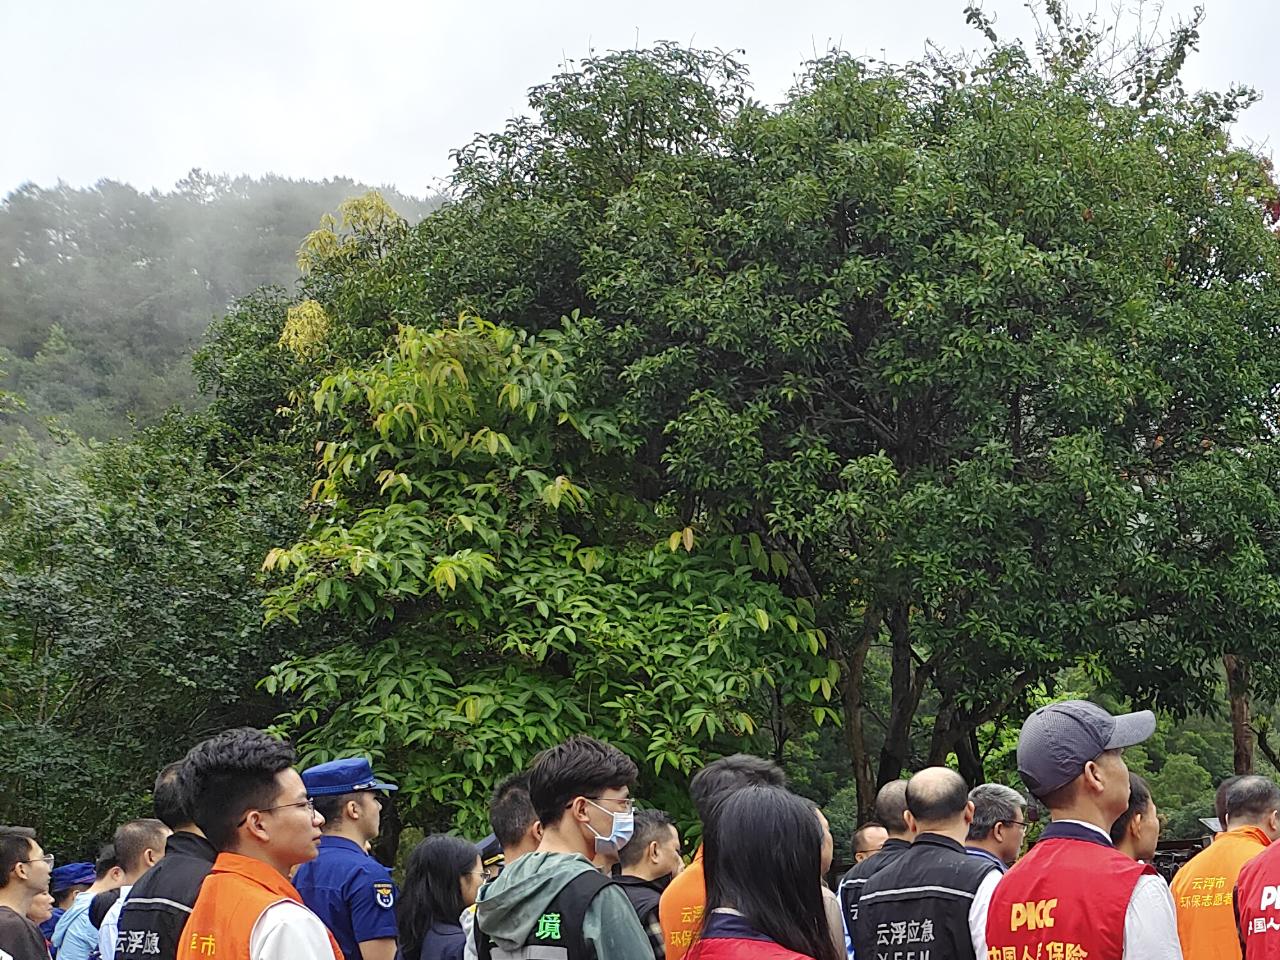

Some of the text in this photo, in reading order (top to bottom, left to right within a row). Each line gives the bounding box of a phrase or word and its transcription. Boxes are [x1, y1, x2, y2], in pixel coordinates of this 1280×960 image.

[1192, 876, 1227, 890] 云浮市
[1010, 898, 1058, 931] PICC
[876, 918, 936, 946] 云浮应急
